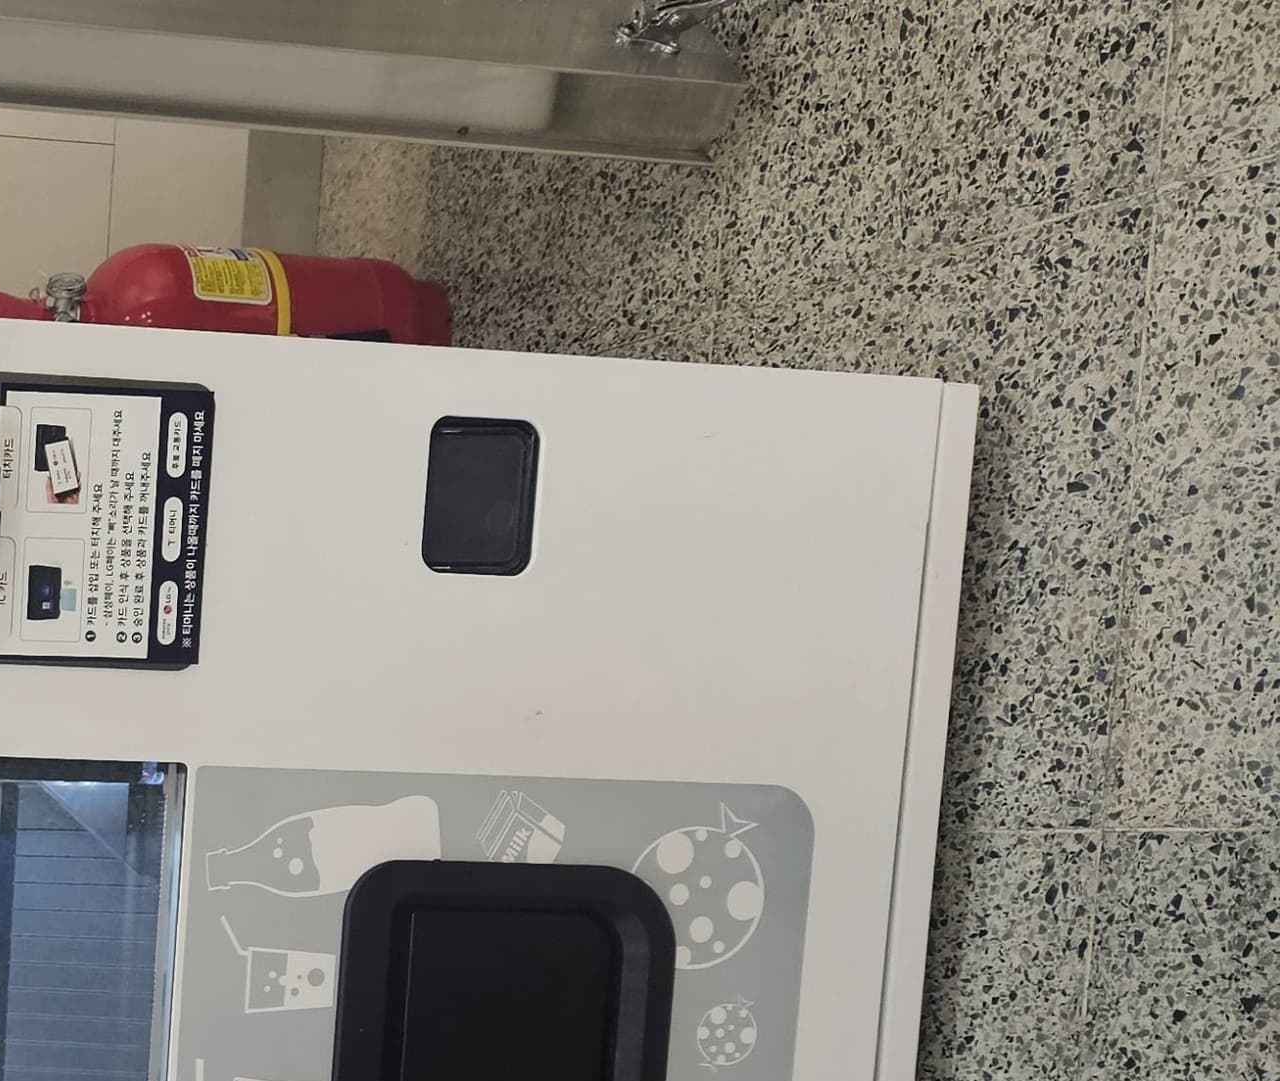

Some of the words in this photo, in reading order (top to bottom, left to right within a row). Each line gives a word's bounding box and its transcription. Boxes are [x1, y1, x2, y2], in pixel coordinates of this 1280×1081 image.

[192, 410, 205, 442] 마세요
[2, 437, 14, 478] 터치카드
[192, 446, 203, 466] 떼지
[92, 484, 103, 513] 주세요
[124, 472, 135, 502] 주세요
[190, 470, 202, 500] 카드를
[90, 516, 102, 546] 터치해
[122, 504, 134, 535] 선택해
[168, 510, 177, 534] 티머니
[186, 504, 200, 556] 나올때까지
[90, 550, 100, 570] 또는
[120, 538, 132, 568] 상품을
[88, 573, 99, 592] 삽입
[119, 571, 130, 581] 후
[184, 559, 197, 590] 상품이
[118, 584, 130, 604] 인식
[87, 596, 98, 625] 카드를
[118, 608, 128, 626] 카드
[182, 593, 195, 634] 티머니는
